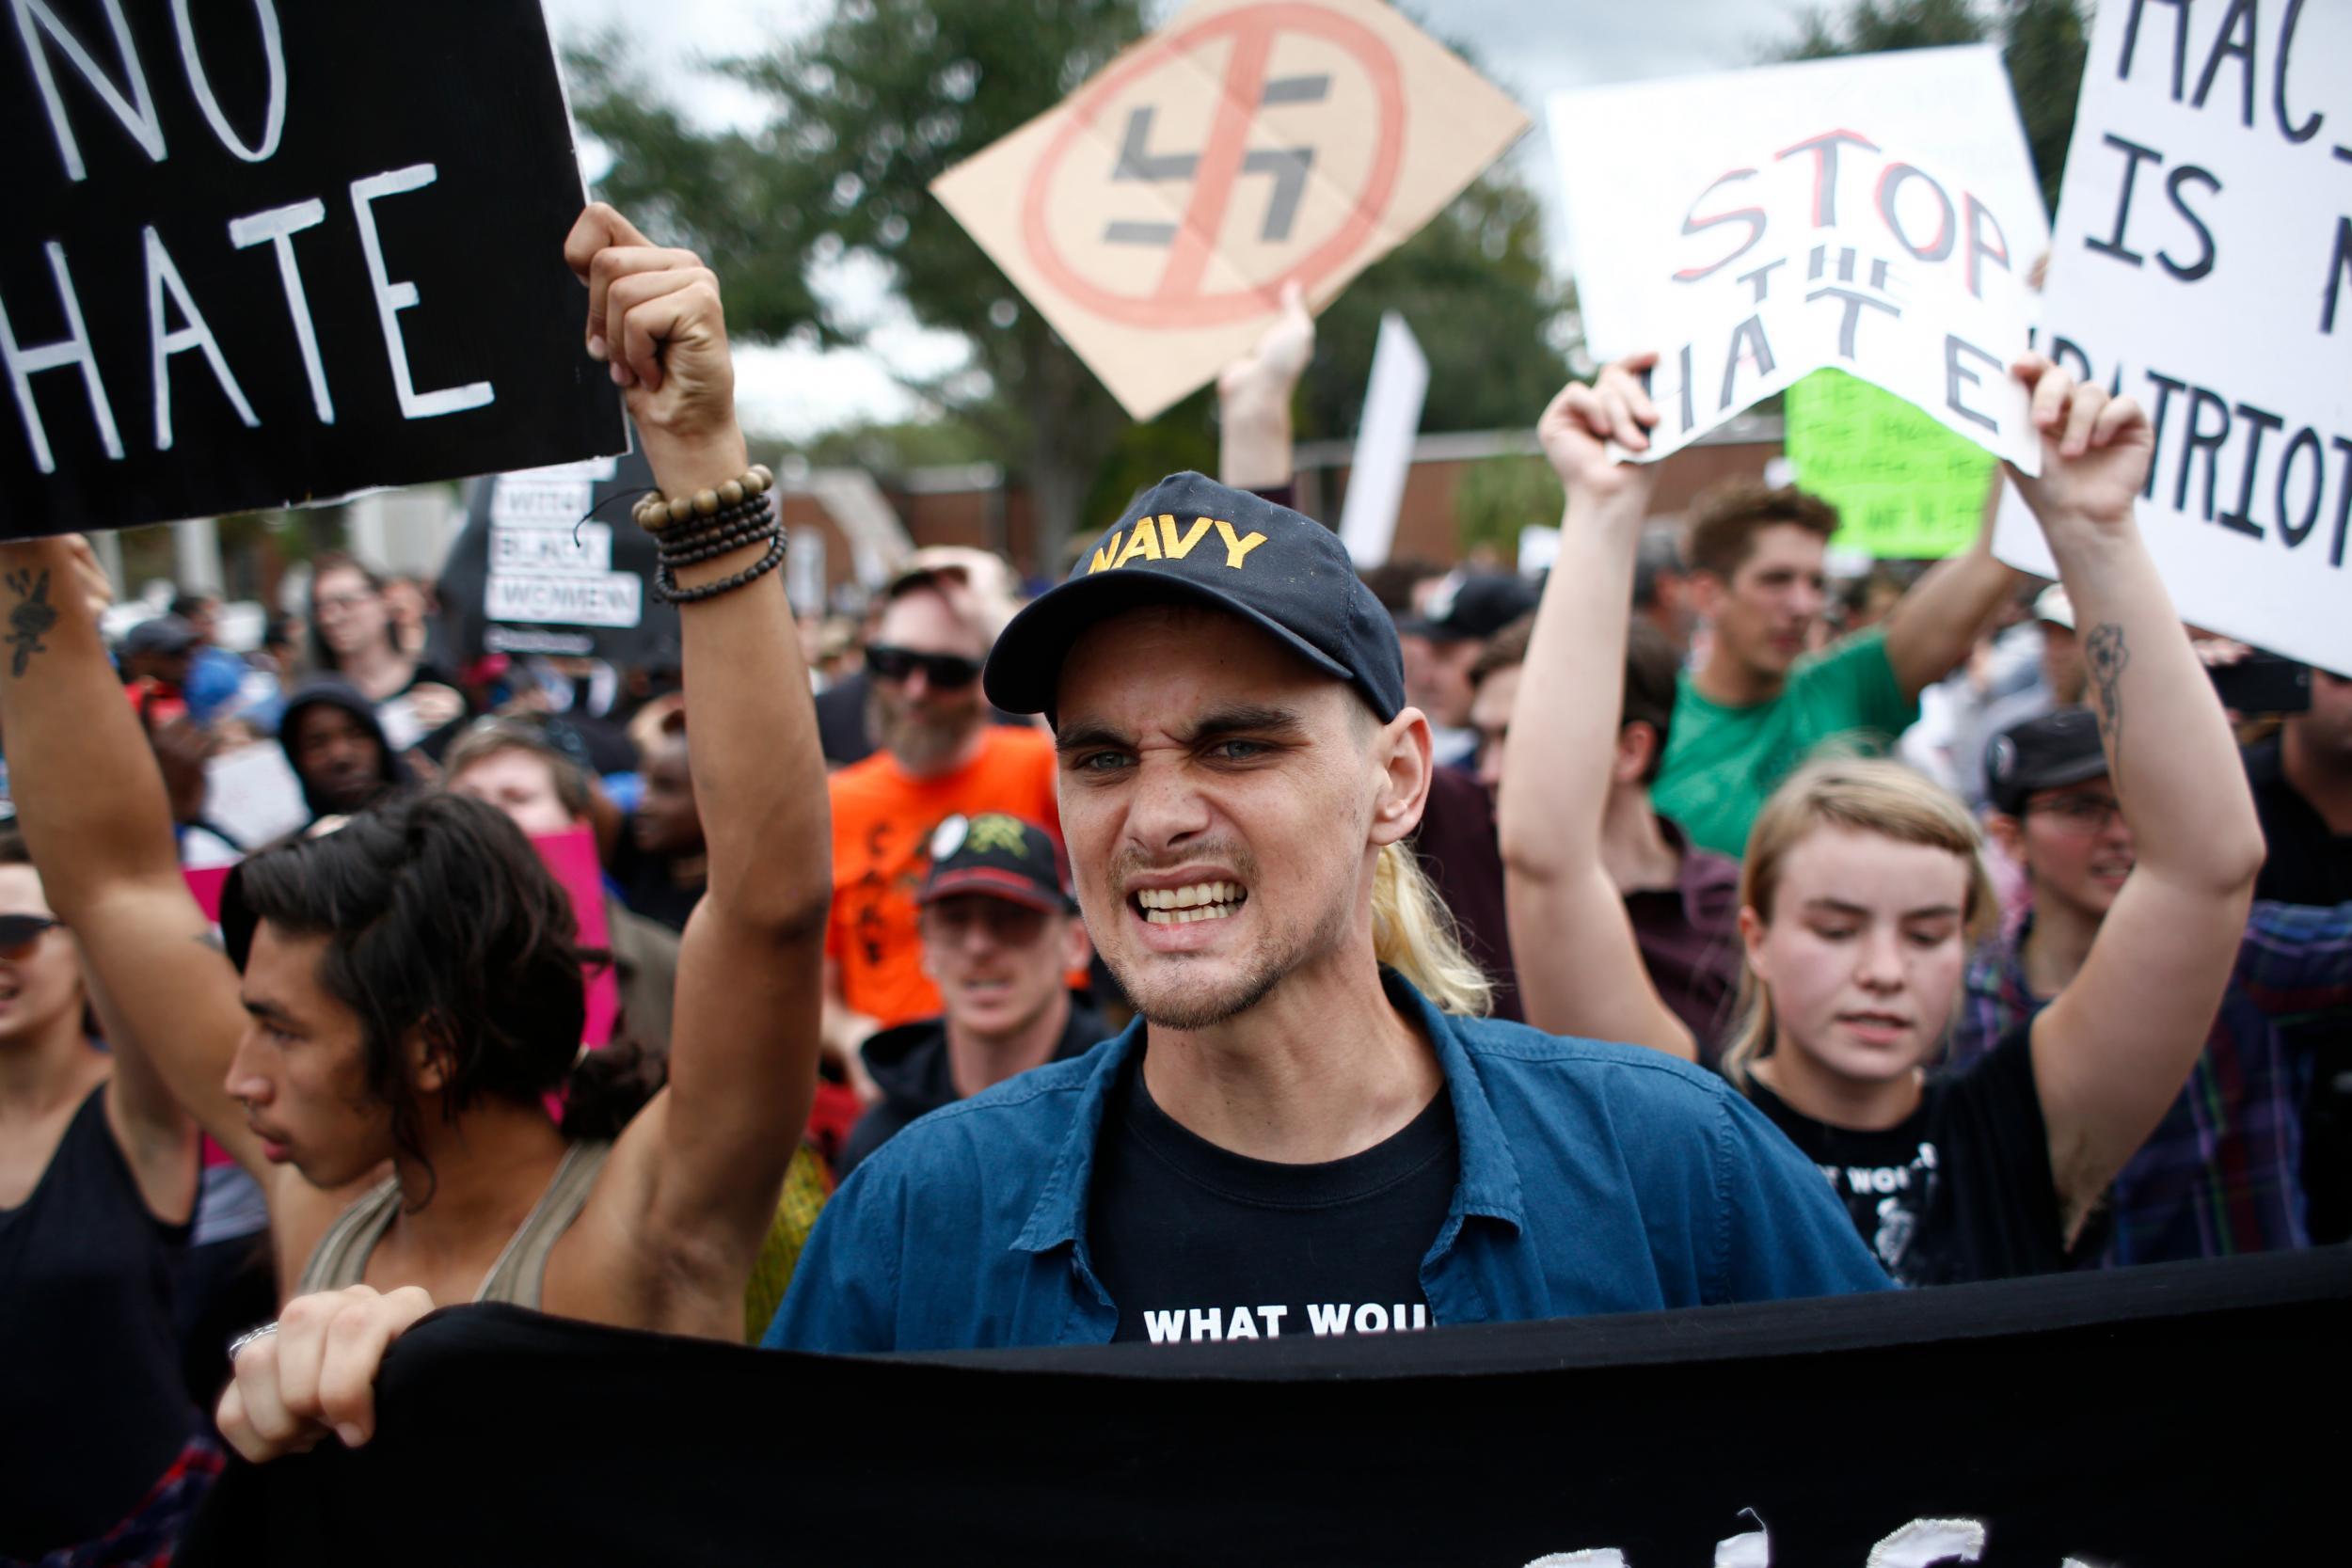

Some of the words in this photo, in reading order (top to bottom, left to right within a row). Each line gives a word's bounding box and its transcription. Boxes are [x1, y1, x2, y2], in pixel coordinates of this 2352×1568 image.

[8, 0, 286, 181] NO
[1671, 128, 2011, 300] STOP
[2084, 131, 2223, 285] IS
[0, 163, 495, 472] HATE
[1736, 245, 1911, 304] THE
[501, 581, 632, 611] WOMEN
[1088, 514, 1269, 575] NAVY
[1142, 1305, 1288, 1345] WHAT
[1306, 1302, 1438, 1338] WOU
